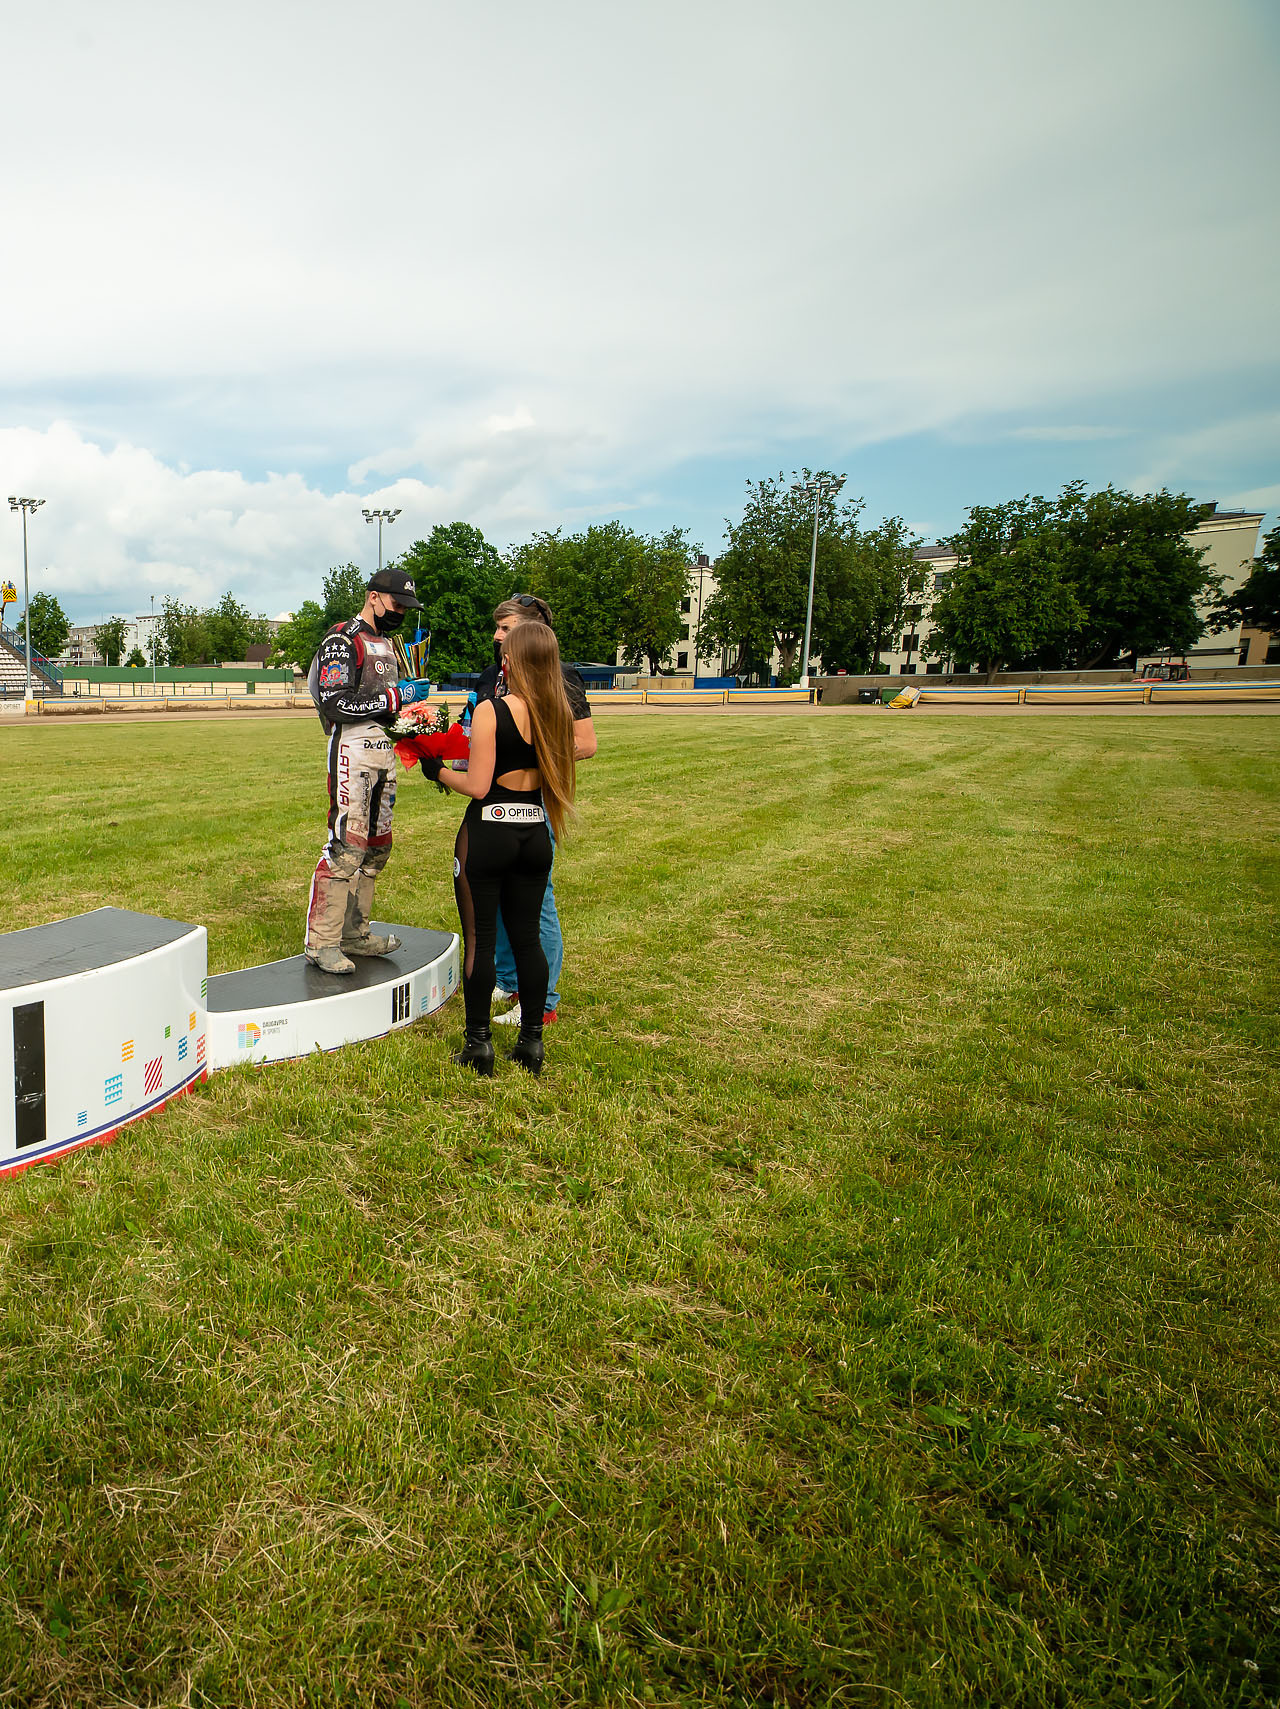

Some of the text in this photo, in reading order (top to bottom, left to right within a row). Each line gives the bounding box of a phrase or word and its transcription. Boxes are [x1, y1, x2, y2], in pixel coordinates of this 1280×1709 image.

[320, 651, 350, 662] LATVIA
[339, 743, 350, 807] LATVIA
[508, 807, 541, 817] OPTIBET
